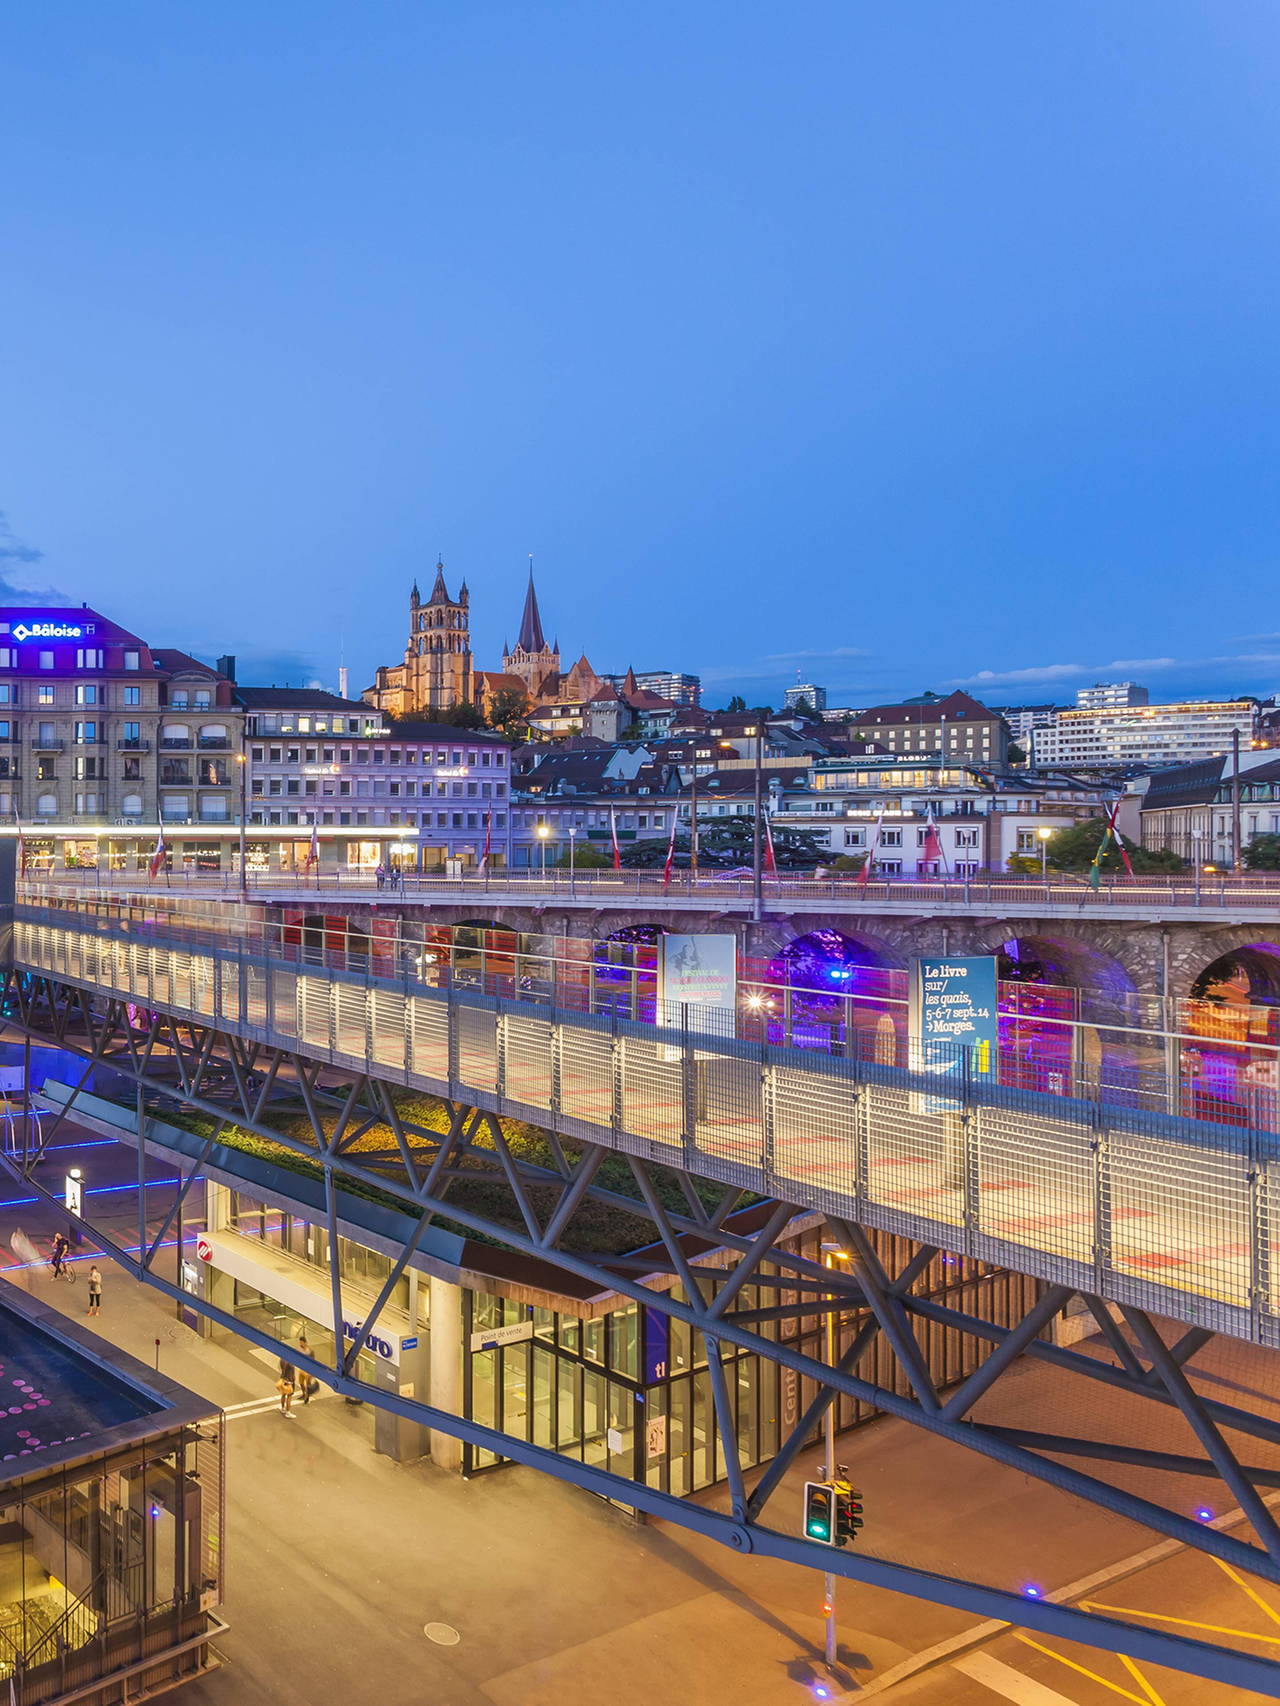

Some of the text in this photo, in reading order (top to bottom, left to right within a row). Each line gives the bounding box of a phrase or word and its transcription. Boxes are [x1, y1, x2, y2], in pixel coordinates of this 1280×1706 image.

[32, 624, 81, 637] Bâloise
[925, 965, 967, 978] Le livre
[924, 979, 949, 992] sur/
[925, 990, 972, 1007] les quais,
[926, 1007, 952, 1020] 5-6-7
[481, 1327, 522, 1342] Point de vente
[655, 1361, 666, 1379] tl
[784, 1362, 797, 1426] Centr
